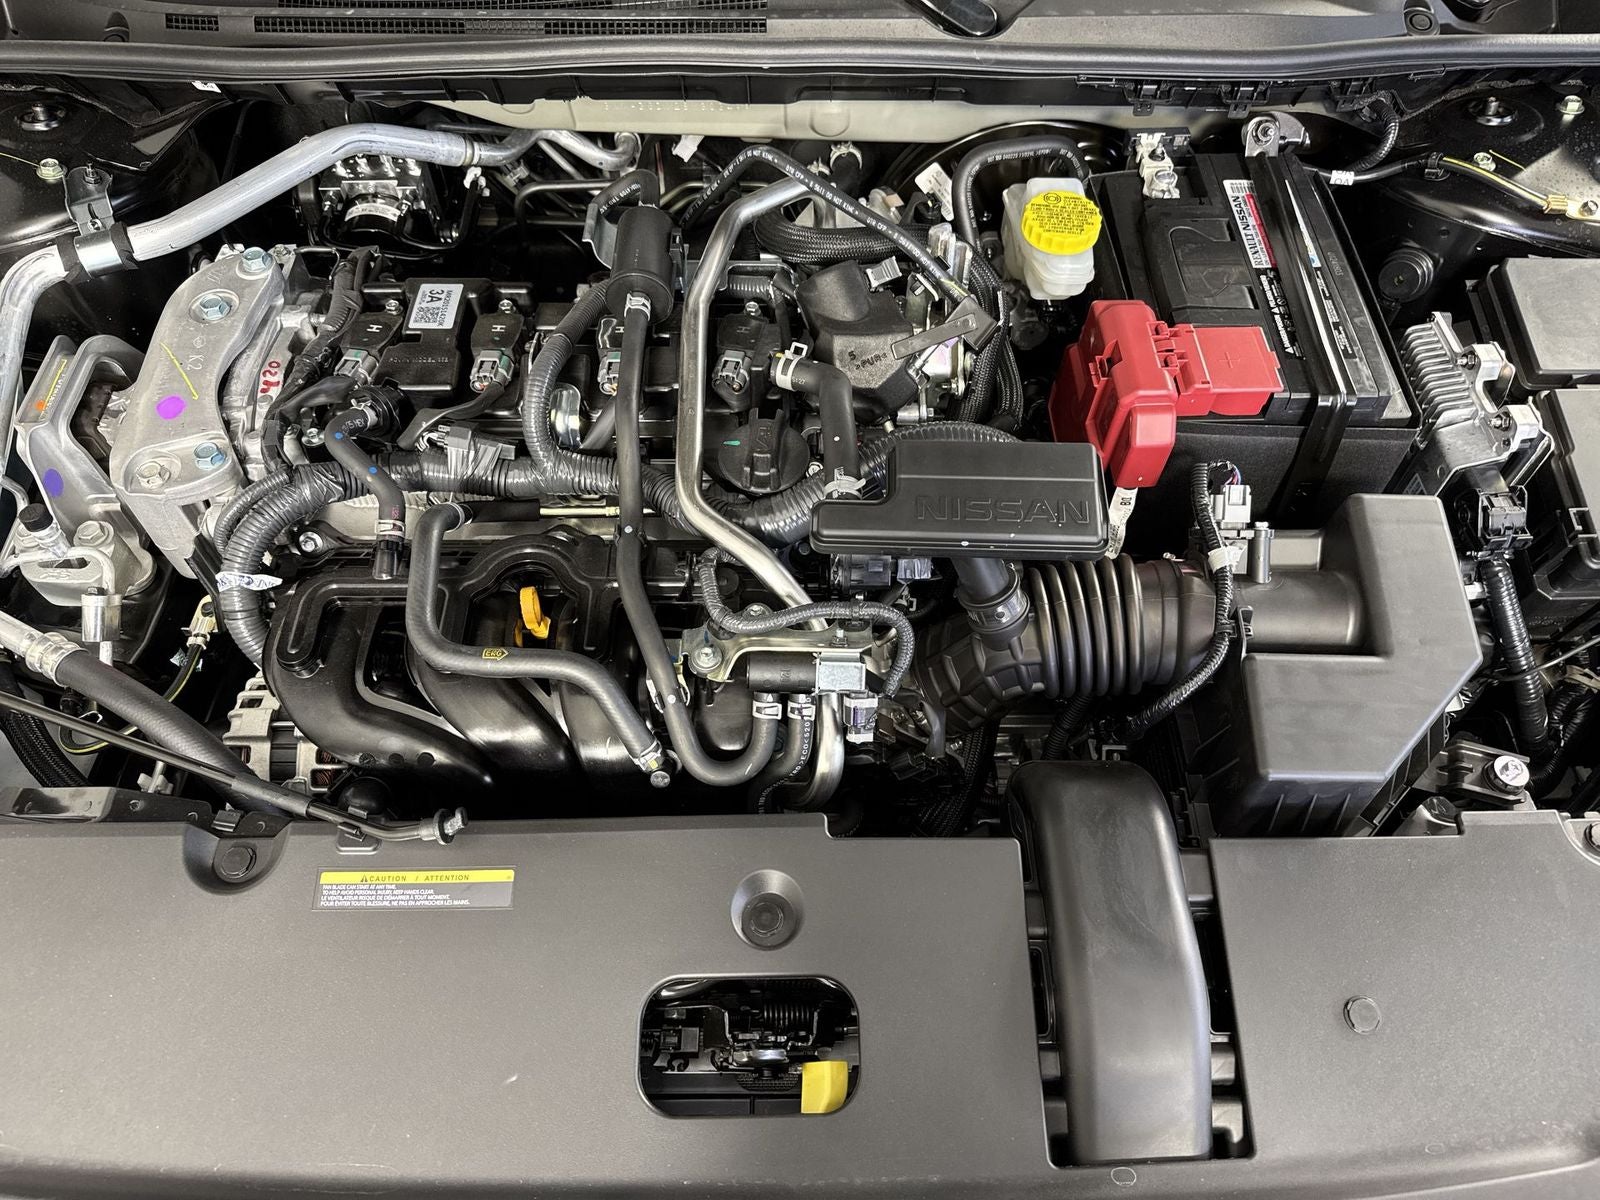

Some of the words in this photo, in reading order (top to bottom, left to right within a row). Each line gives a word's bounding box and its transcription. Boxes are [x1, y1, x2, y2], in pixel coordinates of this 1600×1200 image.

[833, 195, 843, 206] NOT
[1231, 195, 1251, 230] NISSAN
[1245, 233, 1264, 265] RENAULT
[426, 289, 445, 303] 3A
[366, 324, 383, 333] H
[491, 324, 506, 332] H
[187, 354, 205, 371] K2
[916, 496, 1090, 524] NISSAN
[424, 874, 470, 882] ATTENTION
